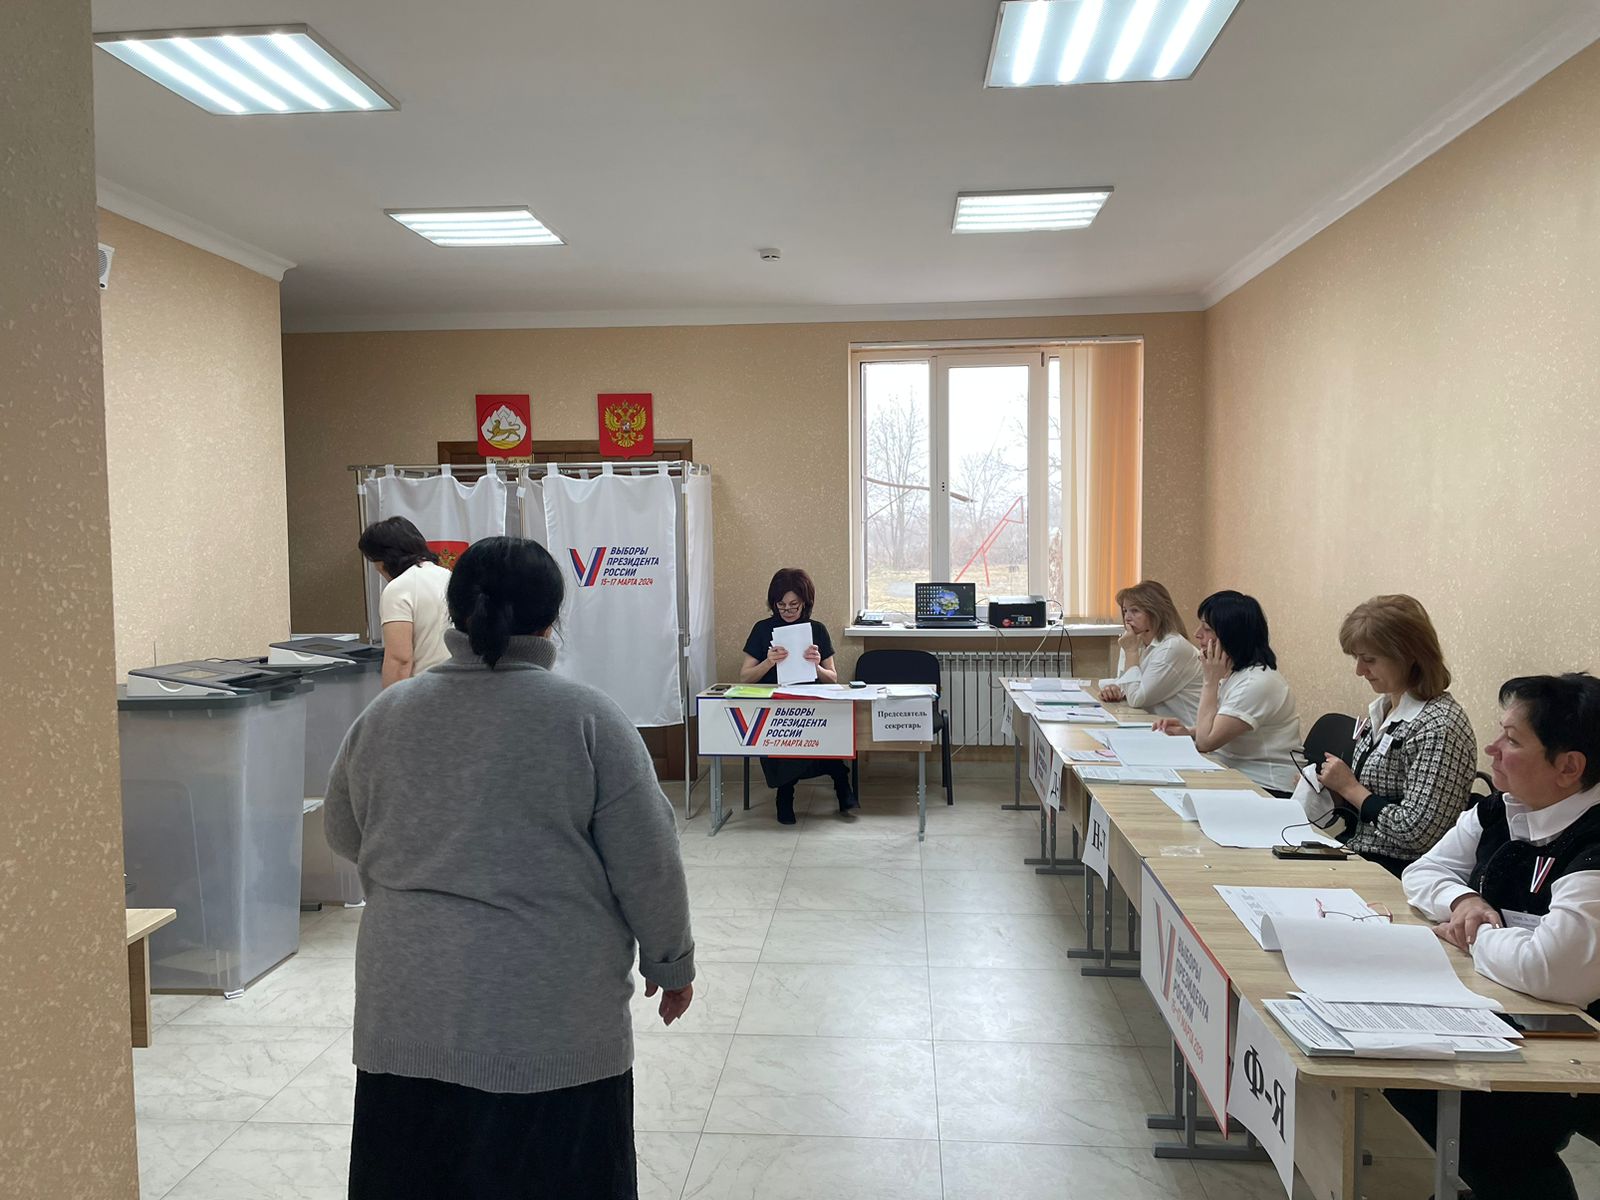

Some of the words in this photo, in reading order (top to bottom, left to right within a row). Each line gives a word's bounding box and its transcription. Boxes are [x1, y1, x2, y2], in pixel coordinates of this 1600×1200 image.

[610, 546, 649, 555] ВЫБОРЫ
[606, 557, 660, 567] ПРЕЗИДЕНТА
[603, 568, 638, 577] РОССИИ
[617, 578, 637, 586] МАРТА
[638, 577, 654, 586] 2024
[775, 707, 816, 717] ВЫБОРЫ
[877, 711, 928, 720] Председатель
[770, 718, 828, 729] ПРЕЗИДЕНТА
[884, 723, 922, 731] секретарь
[766, 729, 803, 738] РОССИИ
[780, 739, 803, 747] МАРТА
[803, 739, 820, 747] 2024
[1177, 936, 1202, 983] ВЫБОРЫ
[1175, 957, 1209, 1023] ПРЕЗИДЕНТА
[1172, 977, 1194, 1023] РОССИИ
[1243, 1043, 1287, 1144] Ф-Я
